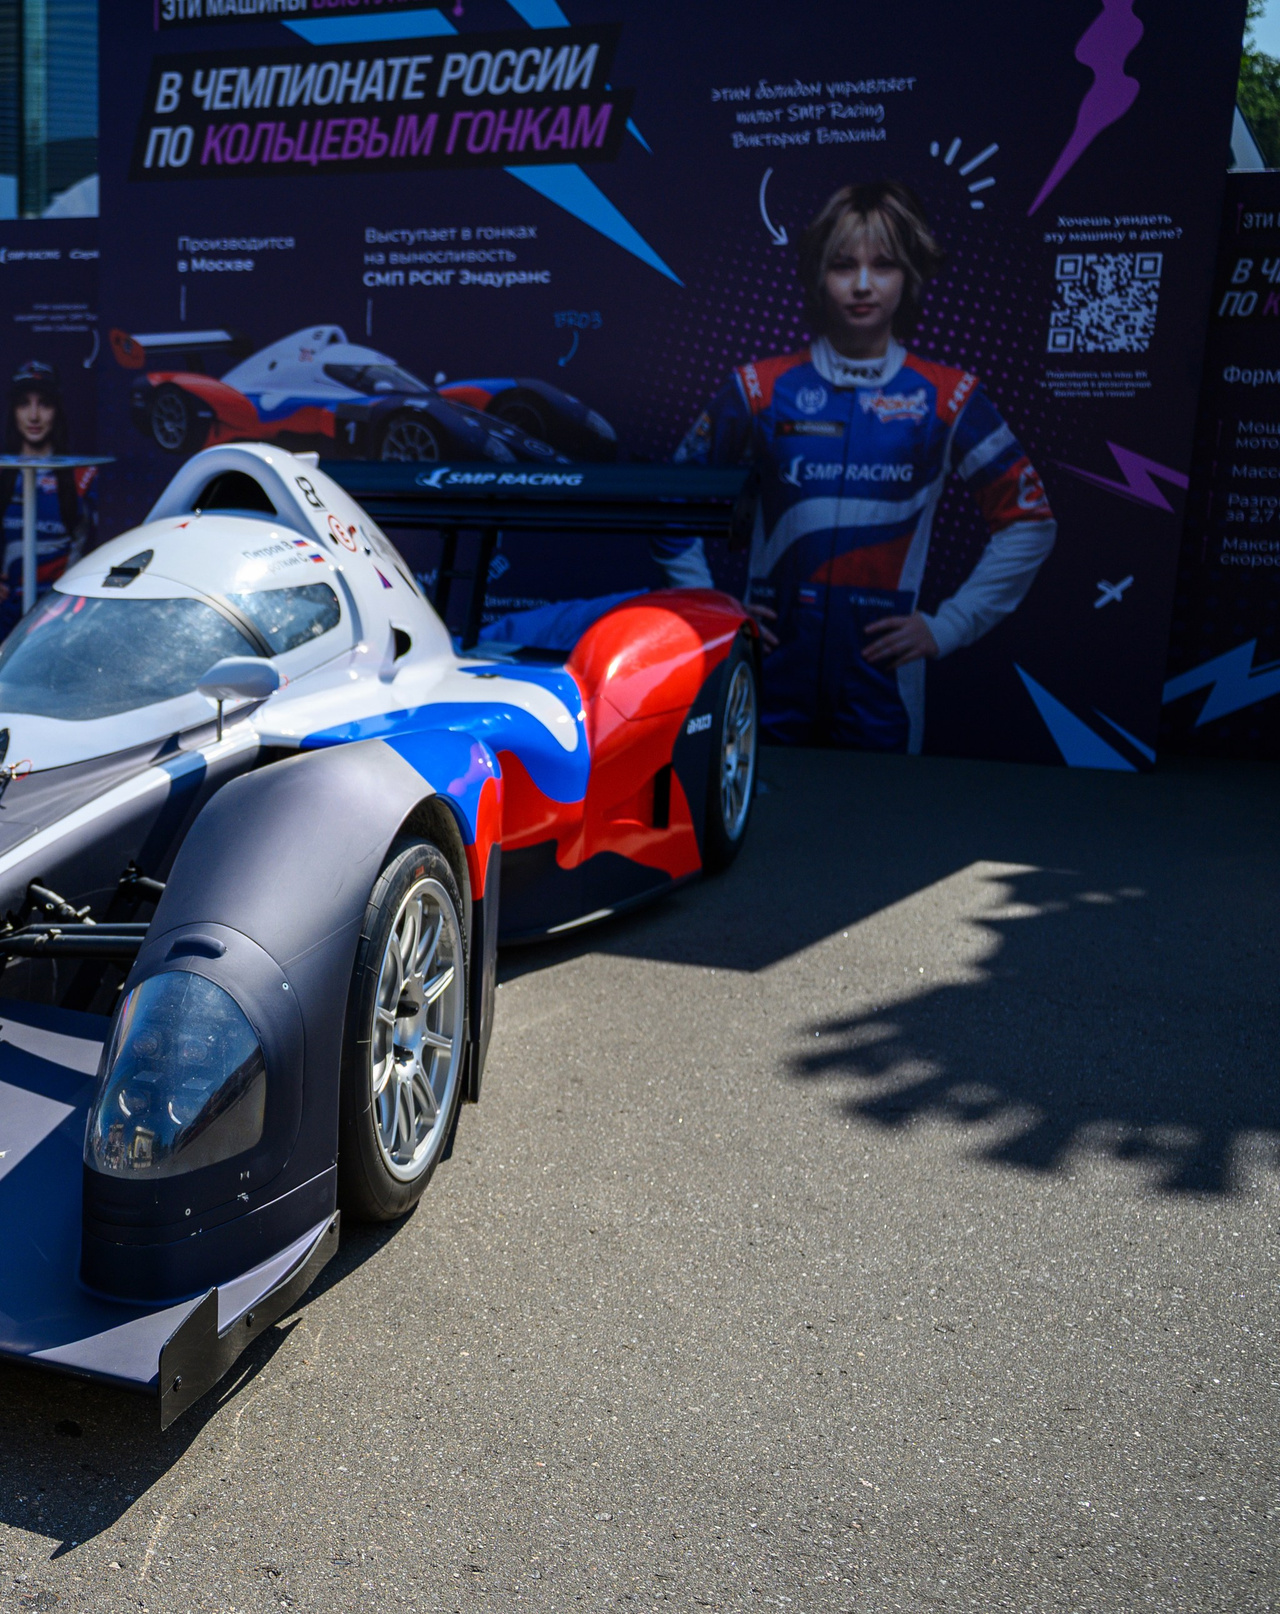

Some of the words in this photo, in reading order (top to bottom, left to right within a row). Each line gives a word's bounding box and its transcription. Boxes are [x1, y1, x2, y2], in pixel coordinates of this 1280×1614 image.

[154, 71, 184, 114] В
[191, 55, 433, 111] ЧЕМПИОНАТЕ
[436, 43, 600, 98] РОССИИ
[143, 124, 195, 168] ПО
[200, 113, 439, 167] КОЛЬЦЕВЫМ
[444, 103, 614, 155] ГОНКАМ
[1057, 215, 1111, 228] Хочешь
[1113, 213, 1173, 228] увидеть
[1242, 211, 1274, 229] ЭТИ
[177, 236, 296, 253] Производится
[364, 227, 457, 246] Выступает
[460, 227, 472, 241] в
[475, 225, 538, 240] гонках
[177, 259, 189, 272] в
[190, 257, 256, 272] Москве
[363, 251, 386, 265] на
[389, 249, 518, 265] выносливость
[362, 271, 405, 287] СМП
[408, 269, 456, 287] РСКГ
[458, 269, 552, 288] Эндуранс
[1230, 257, 1254, 285] В
[1218, 290, 1259, 317] ПО
[446, 472, 497, 486] SMP
[497, 472, 584, 487] RACING
[804, 462, 844, 482] SMP
[844, 463, 914, 483] RACING
